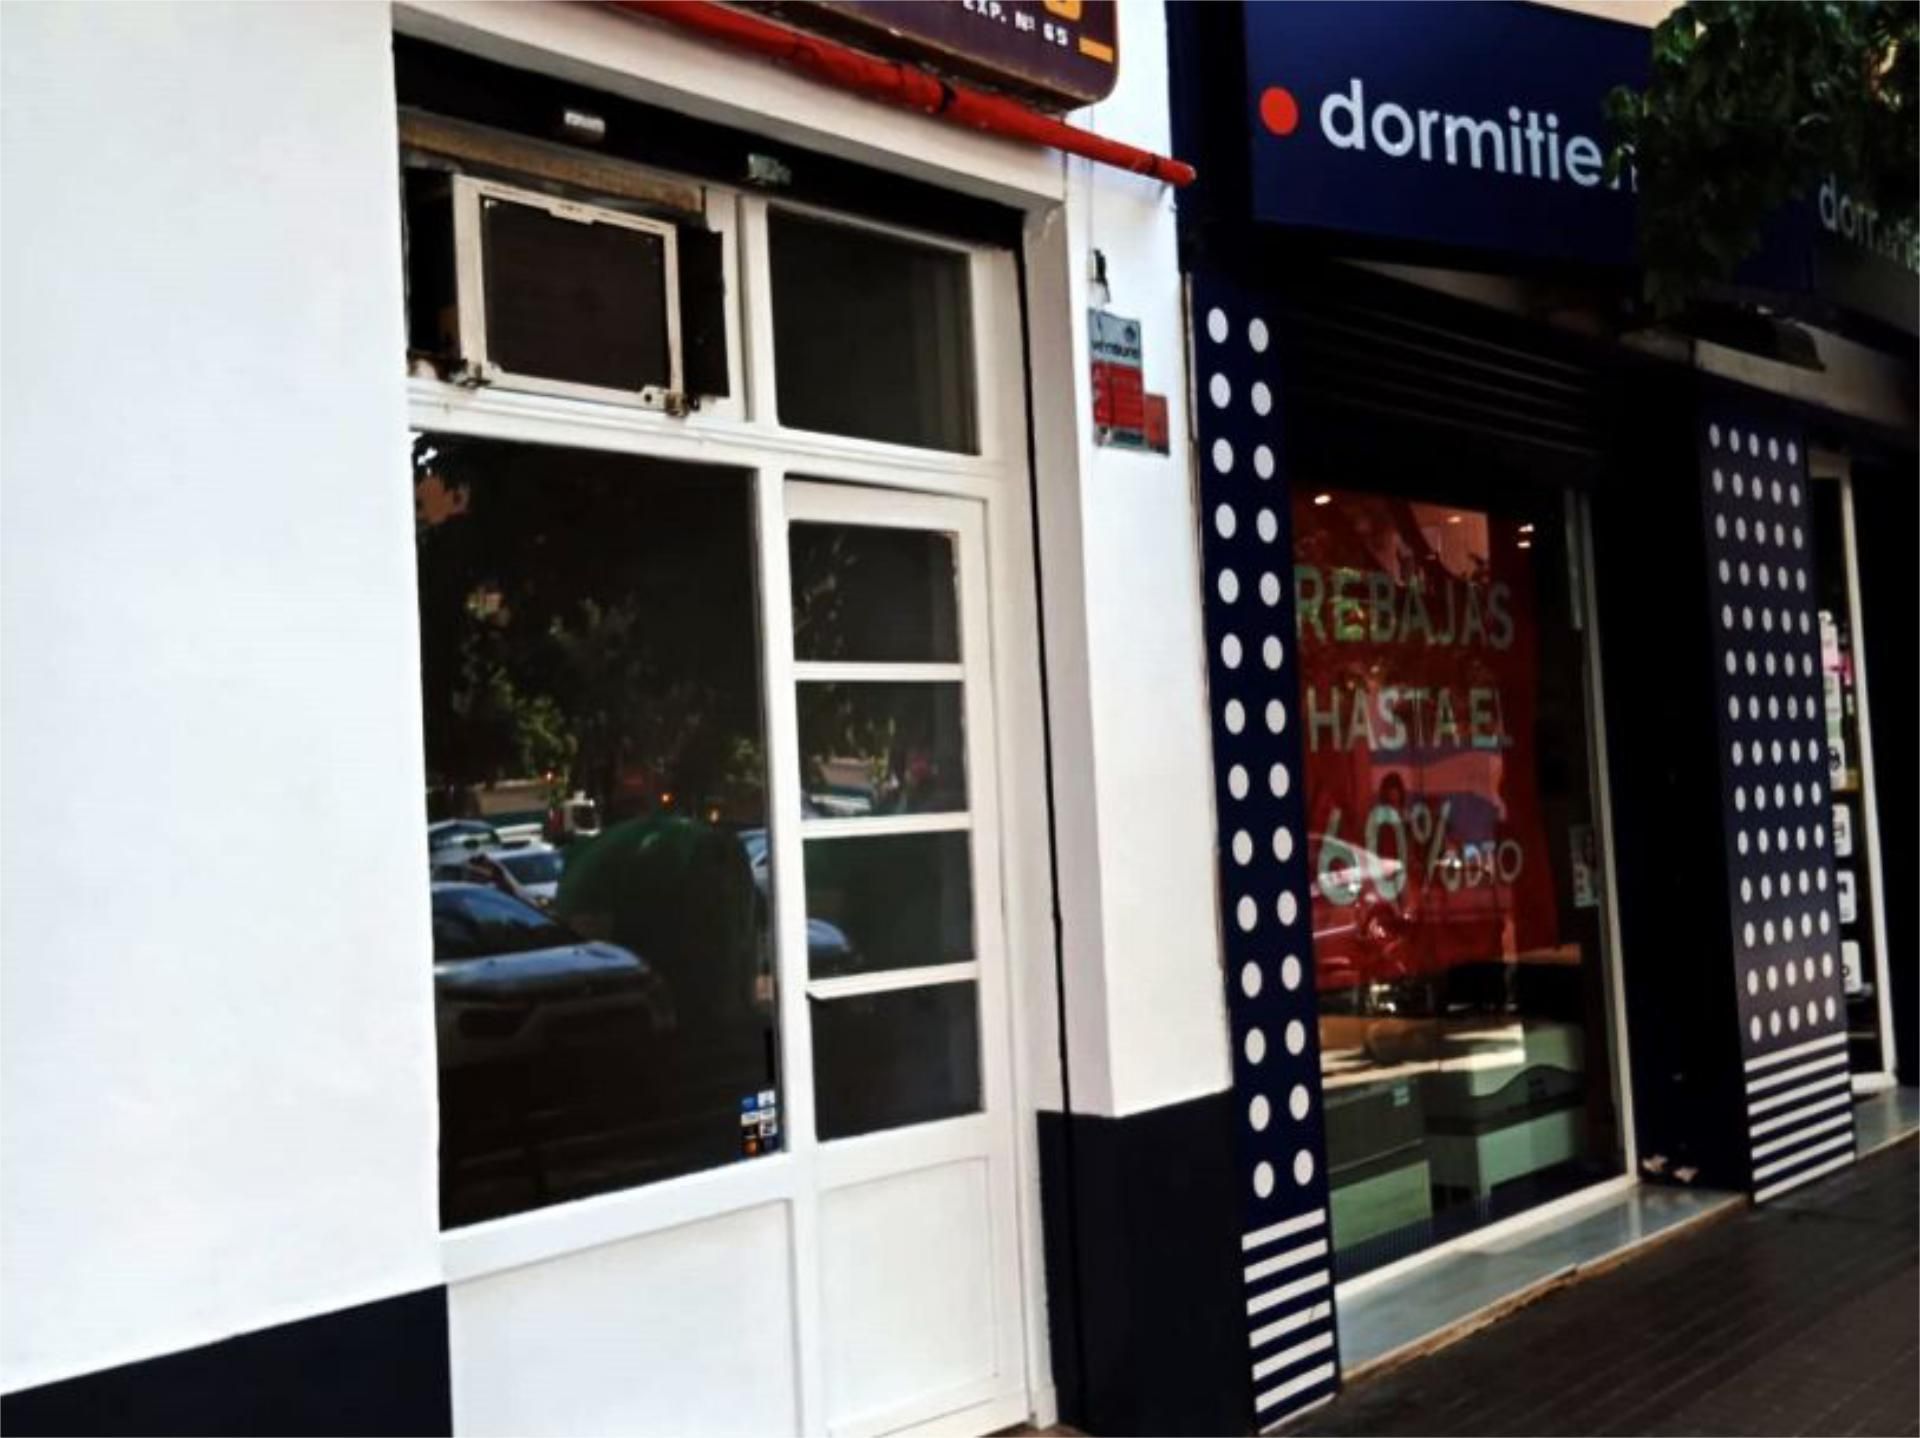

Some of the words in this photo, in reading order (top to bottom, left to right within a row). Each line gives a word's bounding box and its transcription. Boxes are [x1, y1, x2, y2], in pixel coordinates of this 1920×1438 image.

[1044, 23, 1068, 46] 65
[1294, 565, 1513, 650] REBAJAS
[1307, 685, 1461, 752] HASTA
